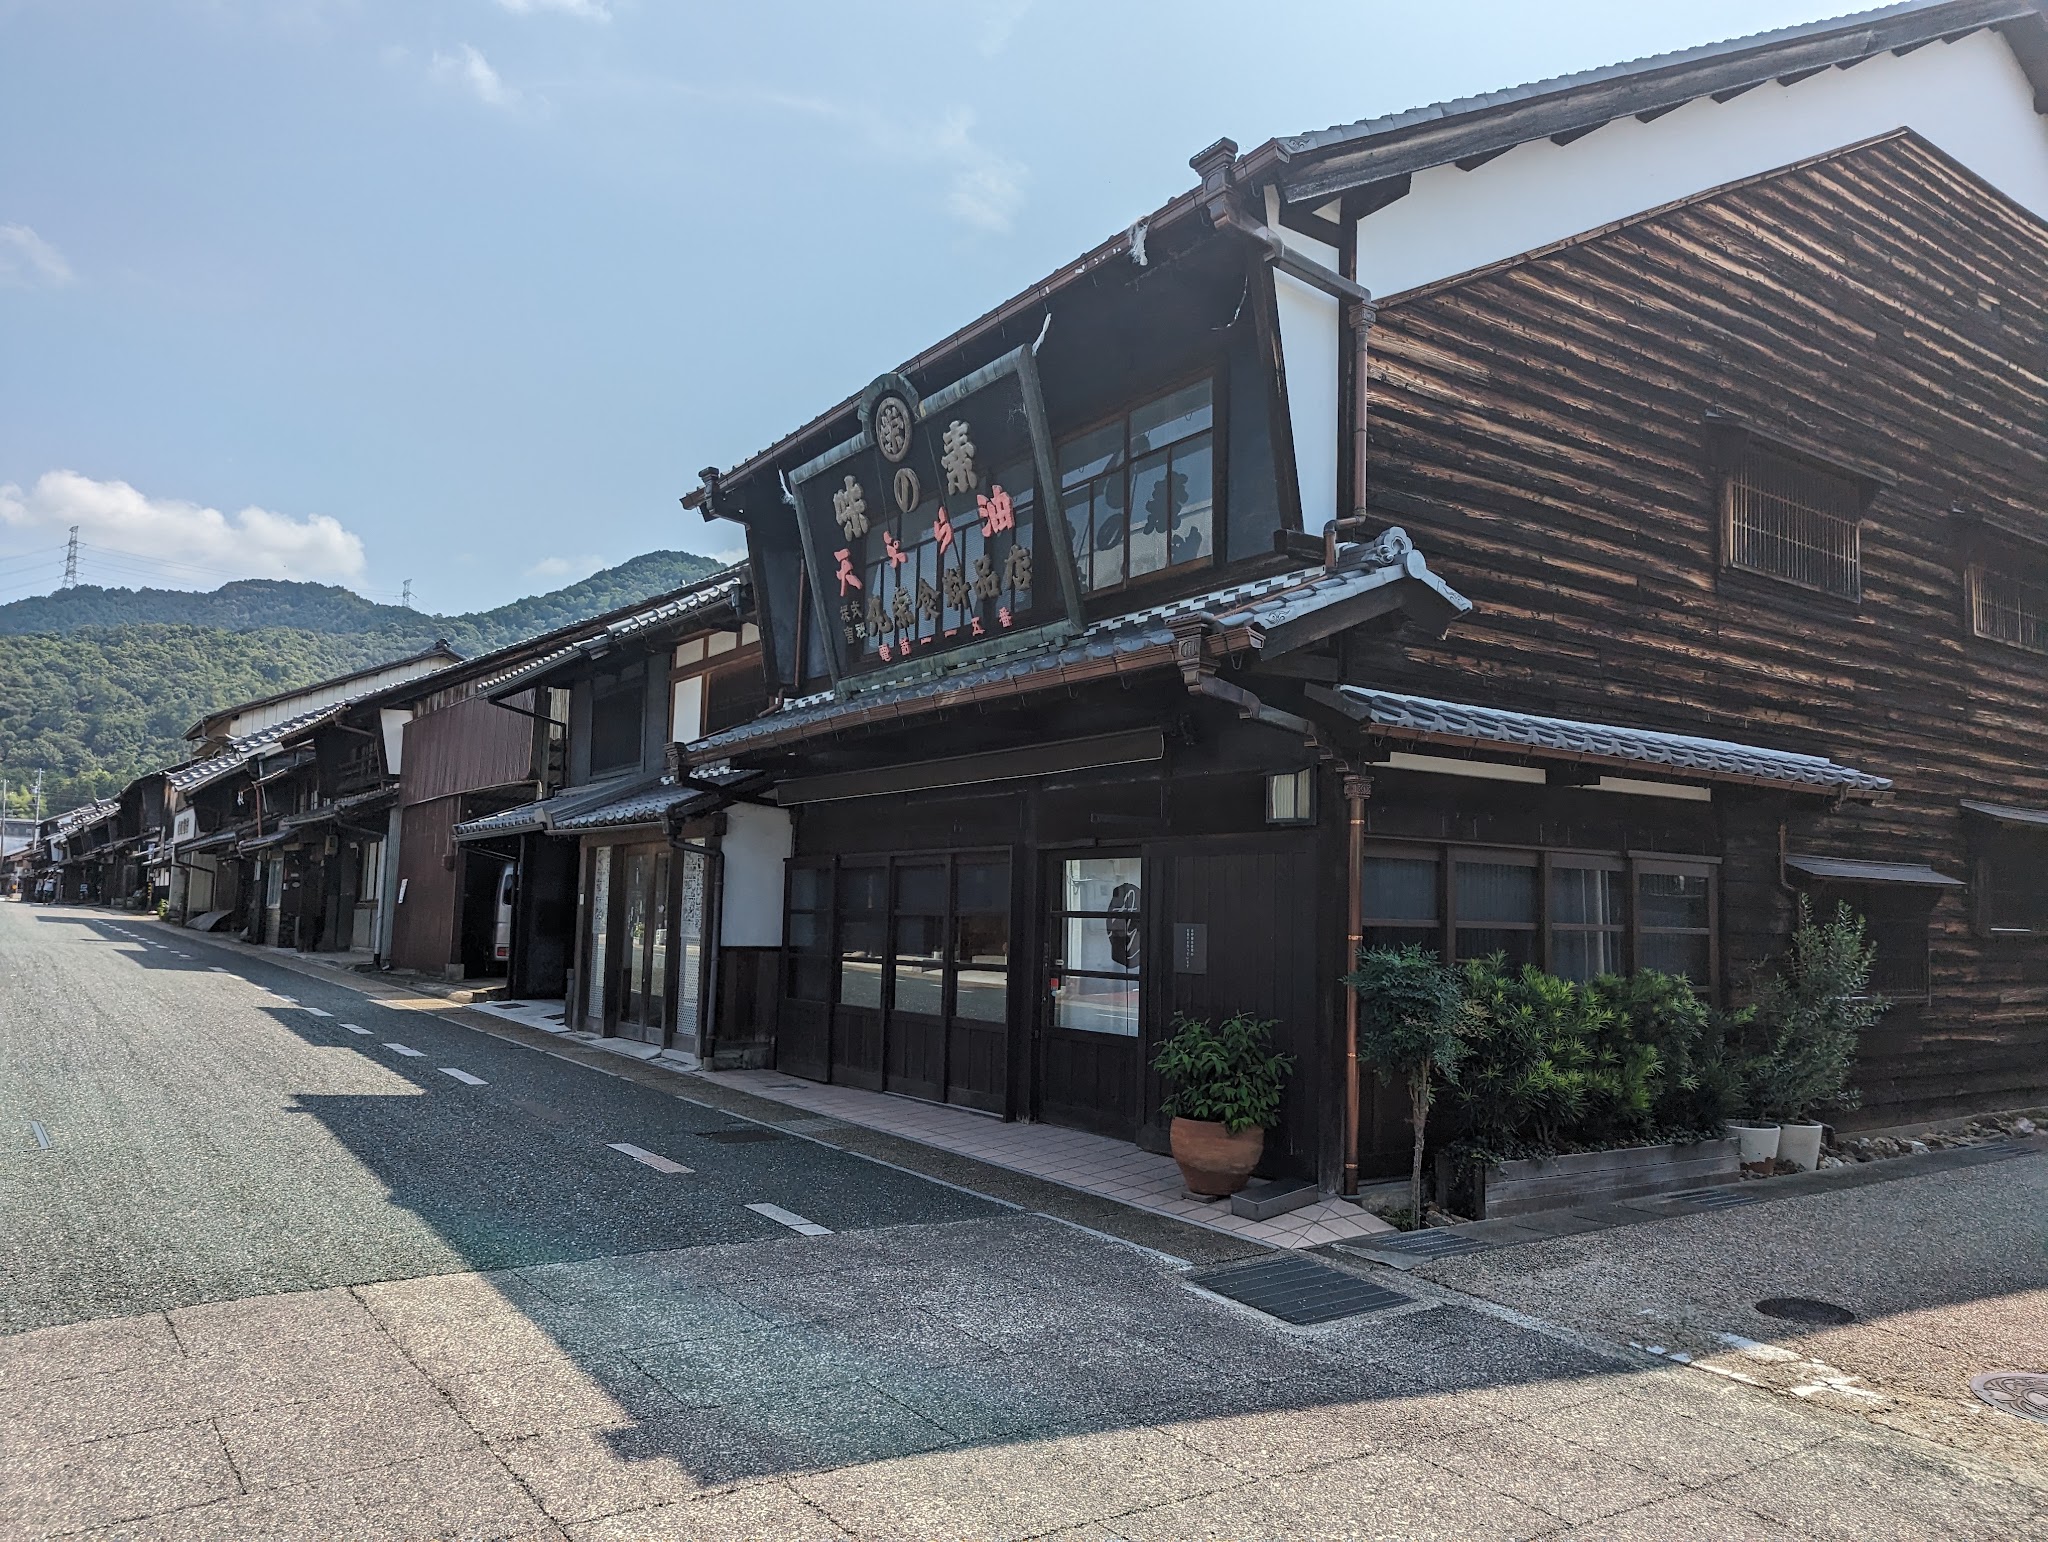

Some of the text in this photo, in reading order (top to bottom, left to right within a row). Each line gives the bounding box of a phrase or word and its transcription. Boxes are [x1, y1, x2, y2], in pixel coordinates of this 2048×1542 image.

[833, 420, 977, 542] 味の素
[834, 485, 1015, 597] 天ぷら油
